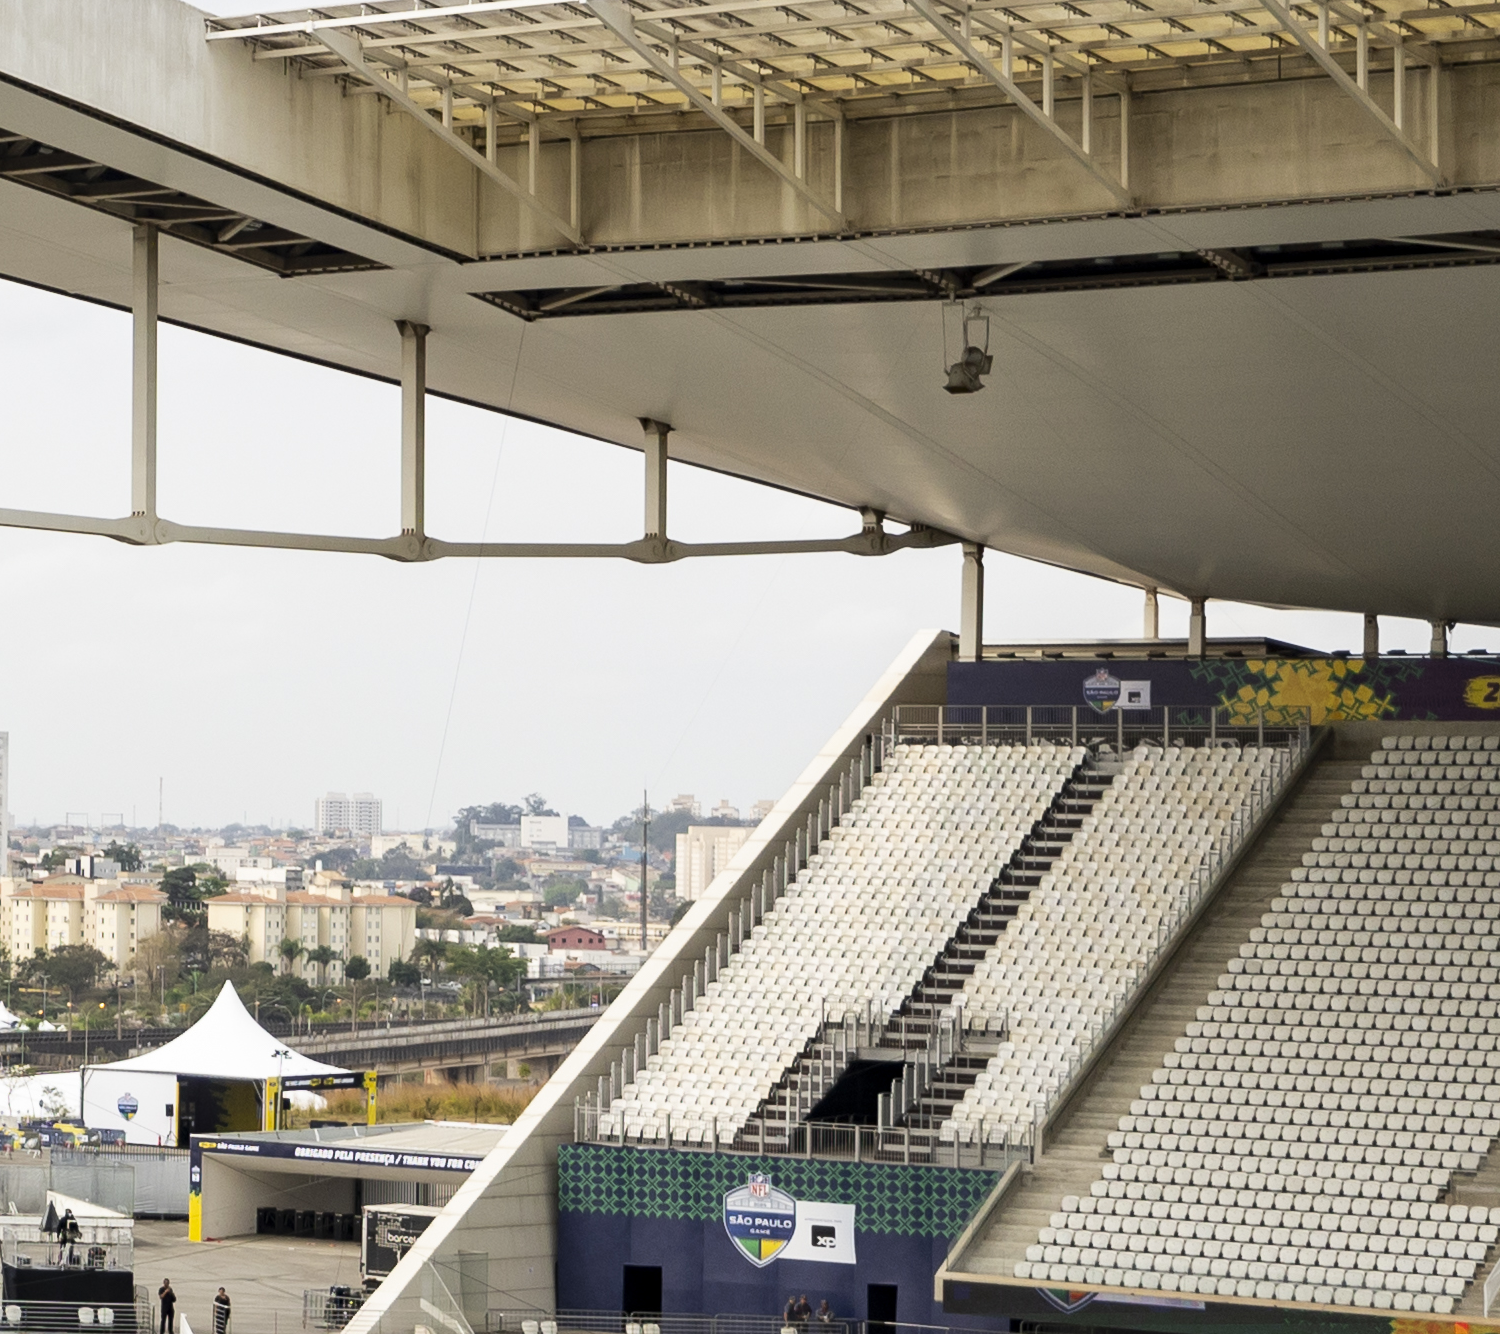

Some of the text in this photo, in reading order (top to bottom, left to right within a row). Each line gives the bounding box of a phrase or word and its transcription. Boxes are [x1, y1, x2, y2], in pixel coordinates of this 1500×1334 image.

[294, 1146, 334, 1160] OBRIGADO
[334, 1149, 354, 1161] PELA
[355, 1151, 395, 1166] PRESENÇA
[402, 1155, 429, 1166] THANK
[430, 1156, 447, 1167] YOU
[447, 1157, 464, 1168] FOR
[750, 1184, 769, 1197] NFL
[729, 1214, 753, 1226] SÃO
[754, 1217, 793, 1229] PAULO
